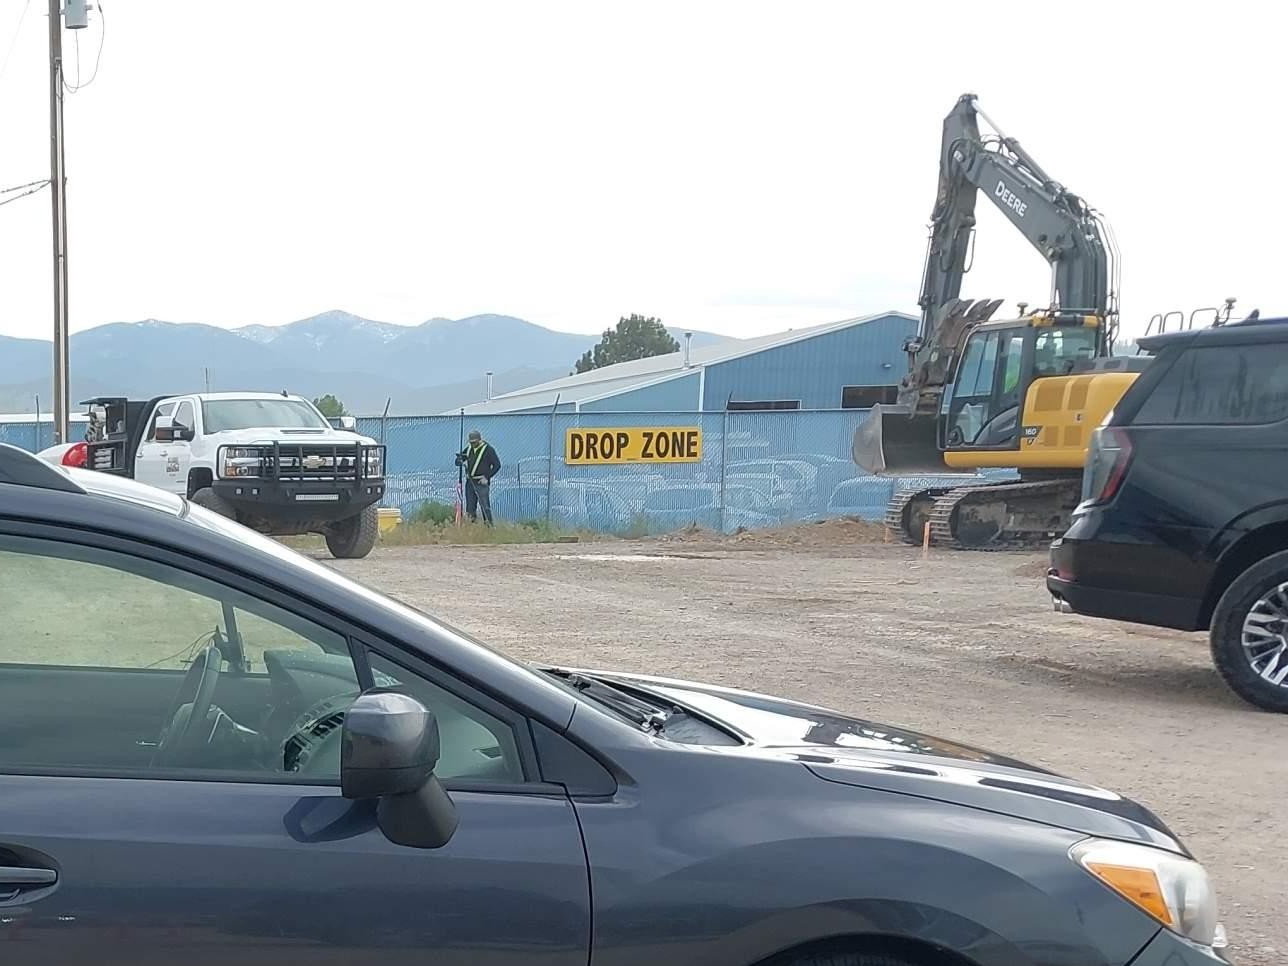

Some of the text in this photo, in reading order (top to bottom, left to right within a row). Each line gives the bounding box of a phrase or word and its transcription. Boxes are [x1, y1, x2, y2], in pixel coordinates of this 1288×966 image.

[995, 180, 1028, 217] DEERE
[570, 431, 698, 460] DROP ZONE
